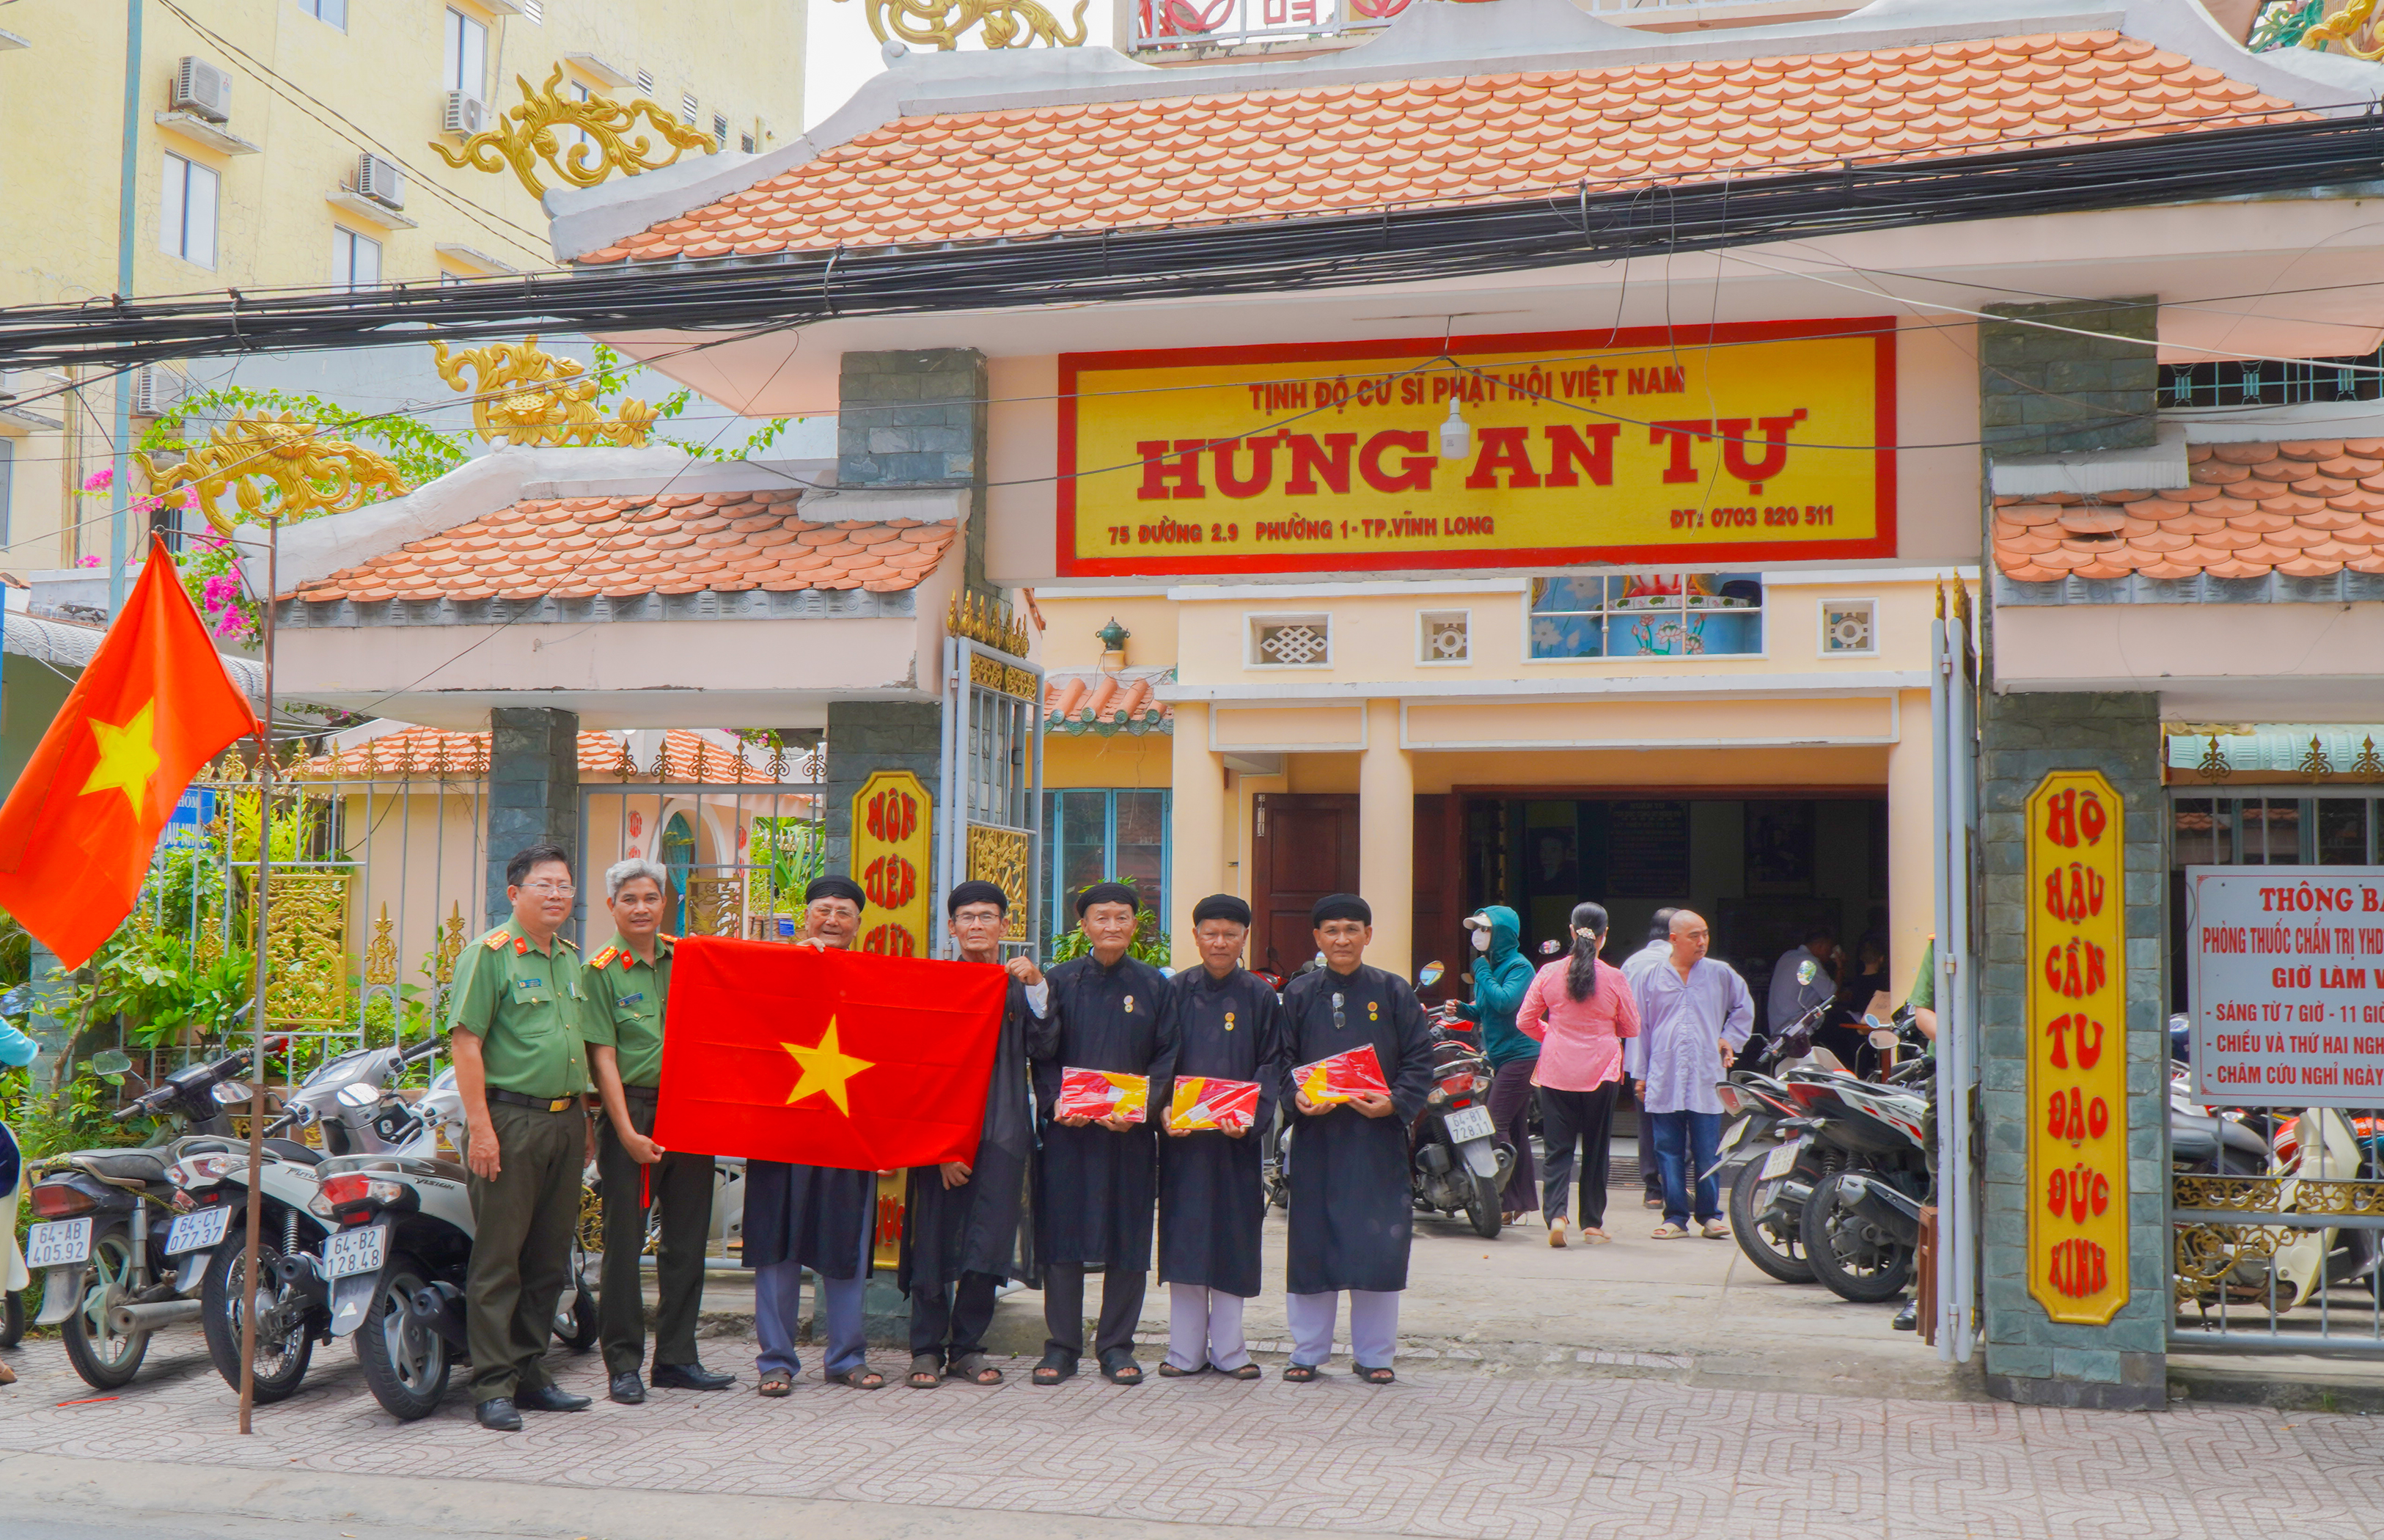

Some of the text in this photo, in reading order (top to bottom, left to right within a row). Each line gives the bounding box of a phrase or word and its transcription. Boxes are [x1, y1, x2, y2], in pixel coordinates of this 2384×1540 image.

[1249, 381, 1307, 416] TỊNH
[1314, 374, 1349, 414] ĐỘ
[1401, 371, 1426, 405] SĨ
[1433, 368, 1500, 408] PHẬT
[1508, 364, 1552, 406] HỘI
[1560, 364, 1618, 404] VIỆT
[1627, 366, 1684, 395] NAM
[1137, 408, 1808, 500] HƯNG AN TỰ
[1108, 526, 1130, 545] 75
[1138, 515, 1203, 543] ĐƯỜNG
[1211, 523, 1239, 542] 2.9
[1255, 512, 1332, 540] PHƯỜNG
[1444, 516, 1494, 536] LONG
[1711, 507, 1757, 528] 0703
[1764, 506, 1799, 527] 820
[1805, 505, 1833, 526] 511
[866, 788, 917, 843] MÔN
[2046, 788, 2107, 848] HỘ
[2045, 862, 2105, 925] HẬU
[2259, 880, 2354, 912] THÔNG
[2203, 917, 2384, 961] PHÒNG THUỐC CHẨN TRỊ YHD
[2272, 964, 2311, 989] GIỜ
[2320, 964, 2366, 989] LÀM
[2216, 1000, 2257, 1021] SÁNG
[2262, 1000, 2281, 1022] TỪ
[2284, 1005, 2293, 1022] 7
[2299, 1000, 2324, 1022] GIỜ
[2340, 1005, 2356, 1022] 11
[2046, 1012, 2105, 1070] TU
[2265, 1032, 2285, 1052] VÀ
[2289, 1032, 2319, 1053] THỨ
[2323, 1036, 2348, 1054] HAI
[2218, 1063, 2261, 1083] CHÂM
[2267, 1063, 2297, 1085] CỨU
[2302, 1061, 2338, 1085] NGHỈ
[2343, 1064, 2384, 1085] NGÀY
[1453, 1110, 1482, 1127] 64-B1
[1453, 1121, 1491, 1140] 728.11
[2047, 1087, 2108, 1148] ĐẠO
[2047, 1162, 2109, 1225] ĐỨC
[40, 1222, 81, 1244] 64-AB
[180, 1211, 219, 1233] 64-C1
[170, 1226, 221, 1251] 077.37
[334, 1231, 375, 1255] 64-B2
[34, 1241, 84, 1263] 405.92
[328, 1249, 379, 1276] 128.48
